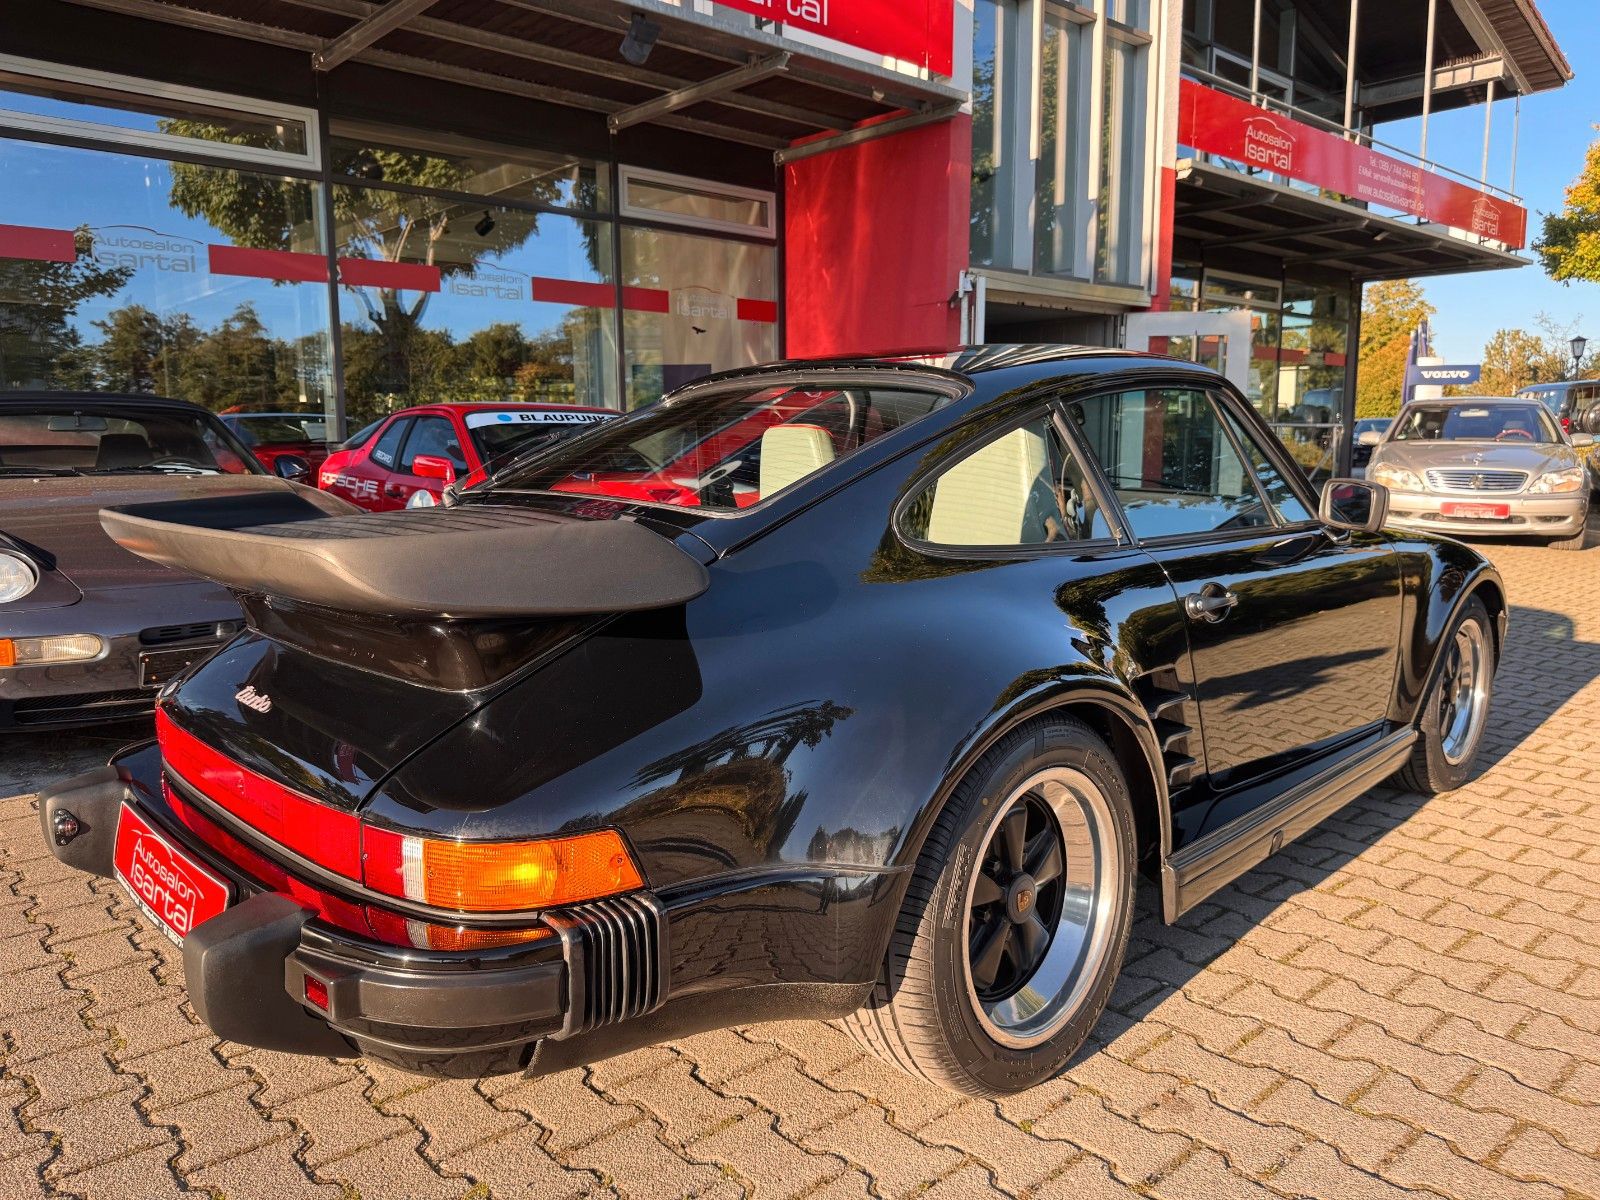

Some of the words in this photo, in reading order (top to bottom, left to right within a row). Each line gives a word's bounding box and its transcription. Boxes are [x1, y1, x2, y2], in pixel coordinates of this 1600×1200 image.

[1245, 124, 1292, 151] Autosalon
[1244, 136, 1292, 170] Isartal
[94, 232, 195, 254] Autosalon
[450, 280, 524, 301] Isartal
[1420, 370, 1471, 379] VOLVO
[519, 413, 613, 422] BLAUPUNK
[321, 472, 379, 494] PORSCHE
[134, 837, 197, 901] Autosalon
[130, 850, 195, 933] Isartal
